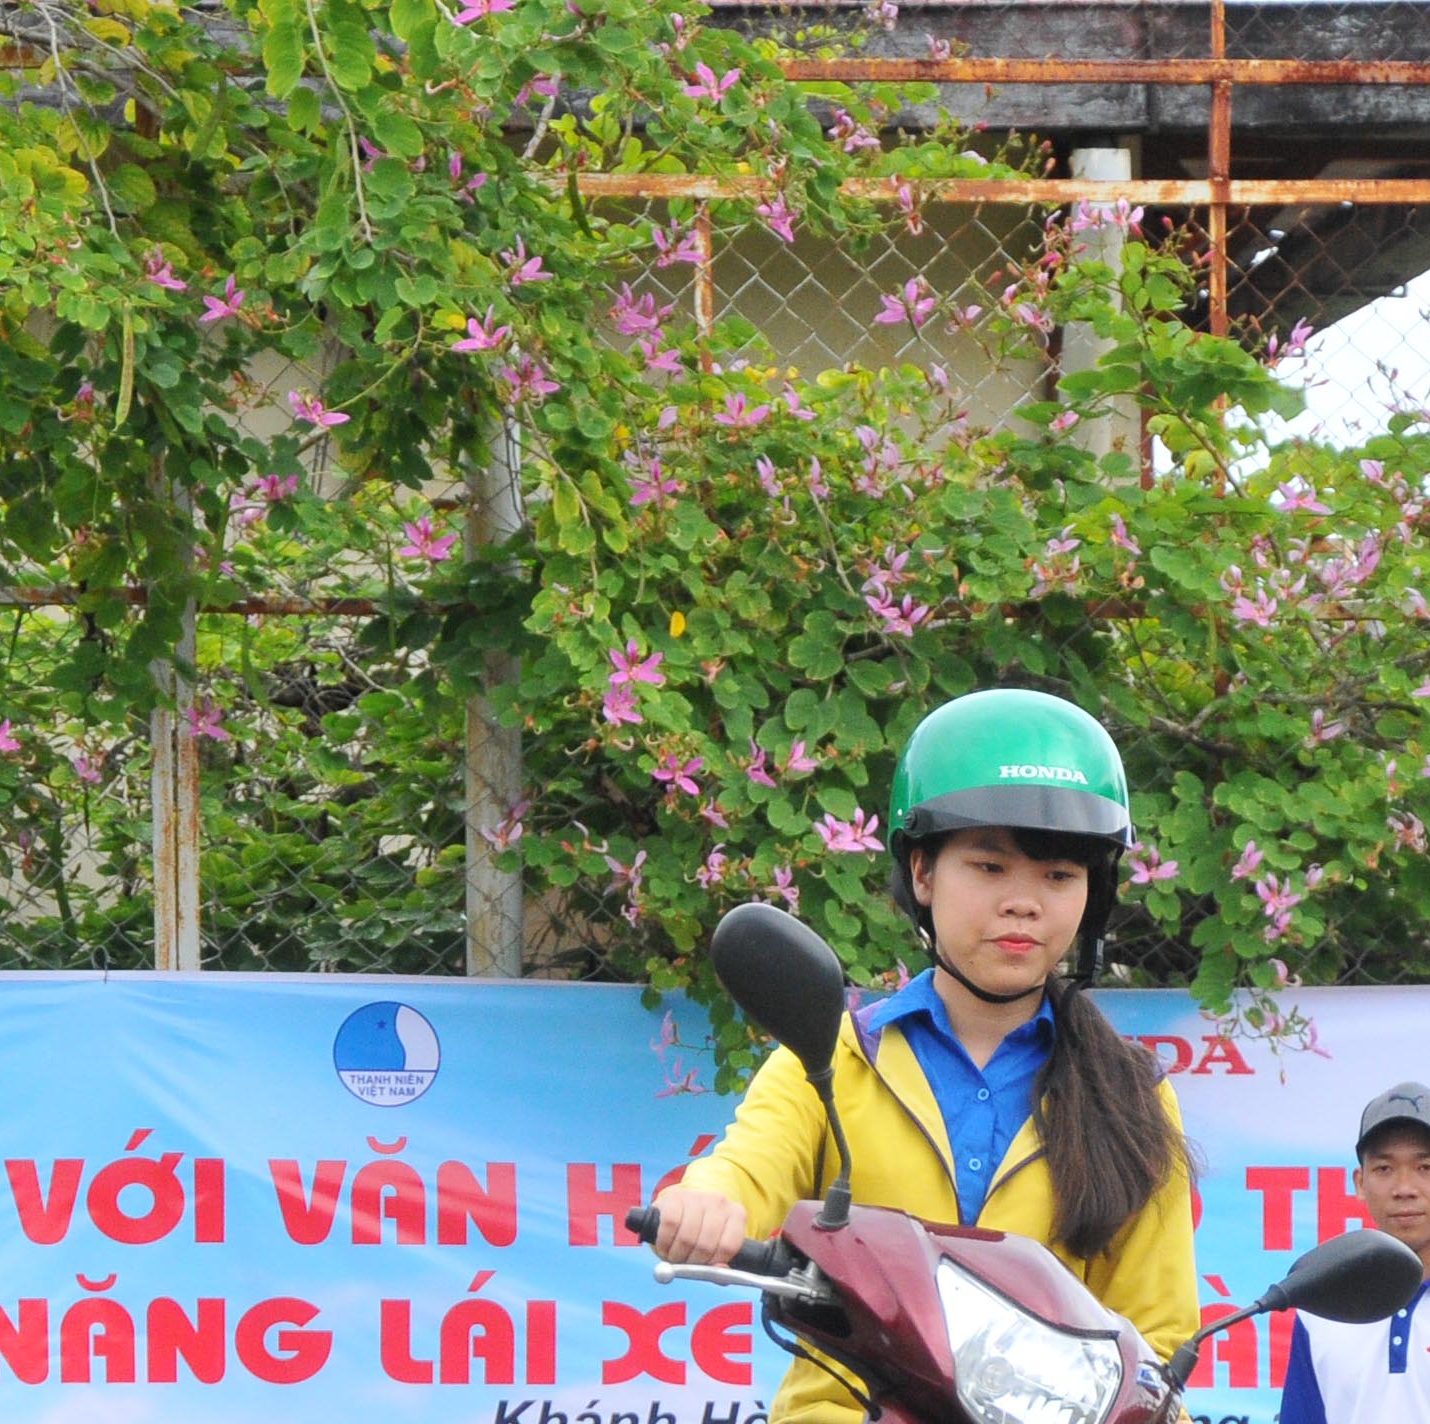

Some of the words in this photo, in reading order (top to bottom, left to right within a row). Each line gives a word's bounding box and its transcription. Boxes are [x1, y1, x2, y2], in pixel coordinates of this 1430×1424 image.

[999, 765, 1088, 784] HONDA
[350, 1074, 391, 1084] THANH
[389, 1086, 415, 1097] NAM
[5, 1129, 225, 1245] VỚI
[269, 1137, 517, 1246] VĂN
[381, 1271, 557, 1385] LÁI
[603, 1301, 753, 1386] XE
